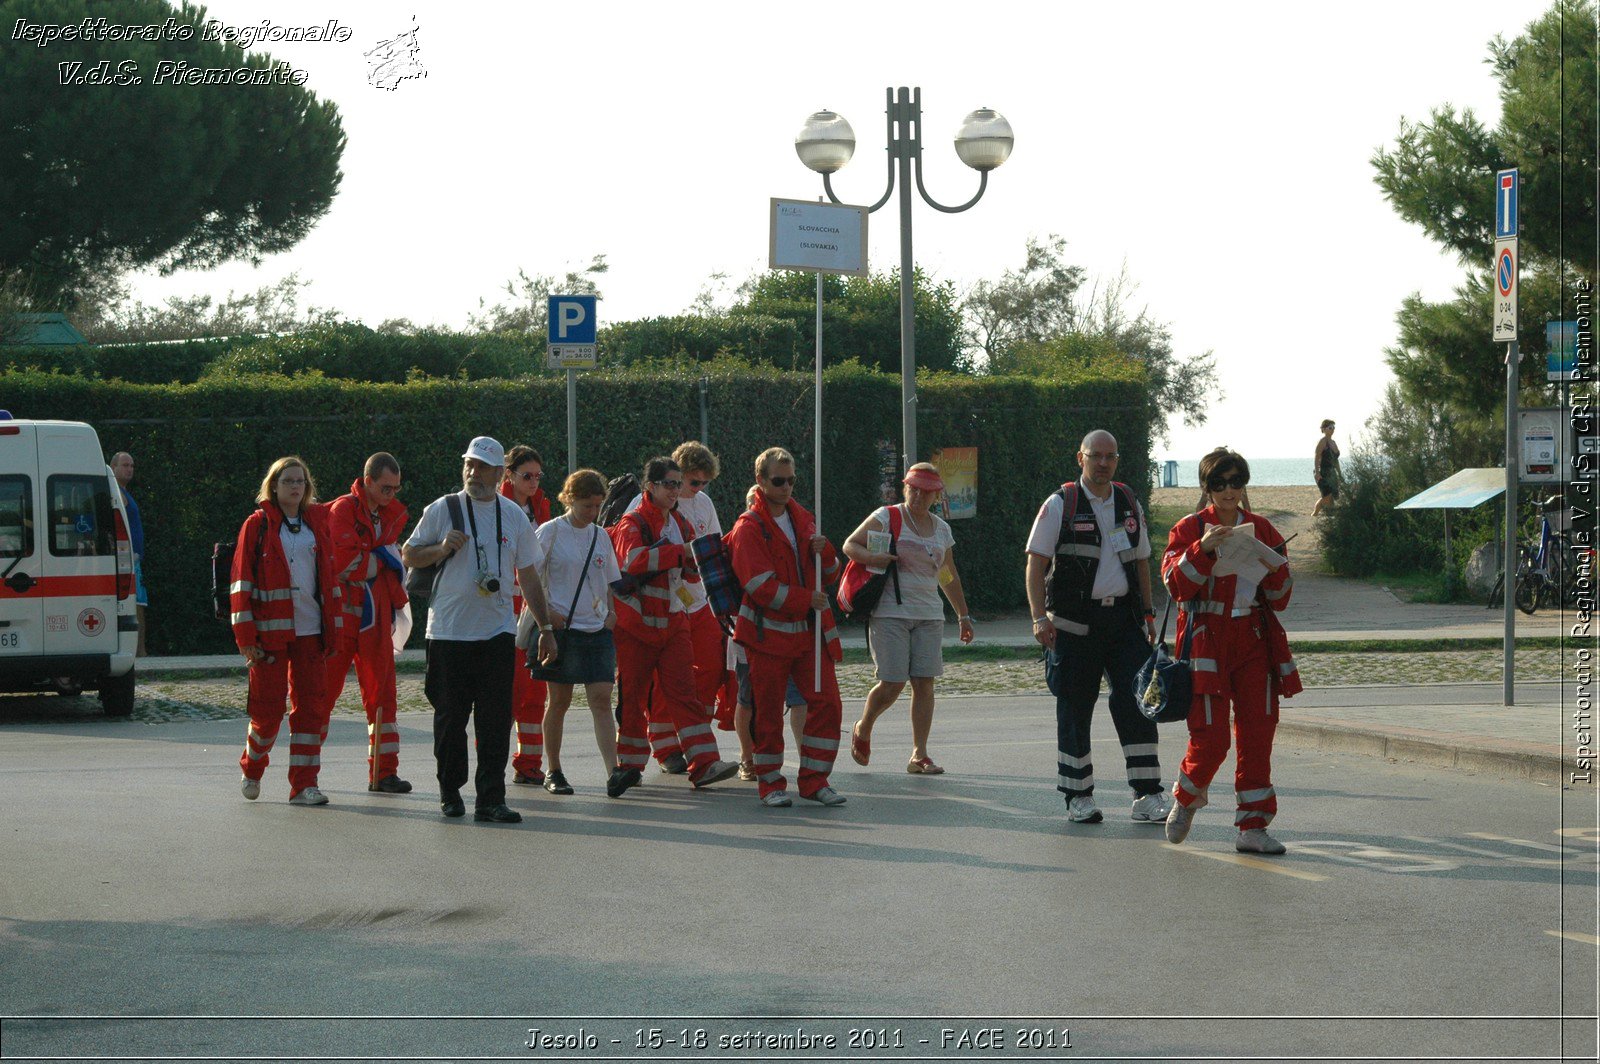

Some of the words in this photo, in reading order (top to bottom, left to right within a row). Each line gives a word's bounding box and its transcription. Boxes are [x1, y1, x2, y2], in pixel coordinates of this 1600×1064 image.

[798, 225, 840, 234] SLOVACCHIA
[799, 242, 838, 251] (SLOVAKIA)
[558, 301, 586, 338] P
